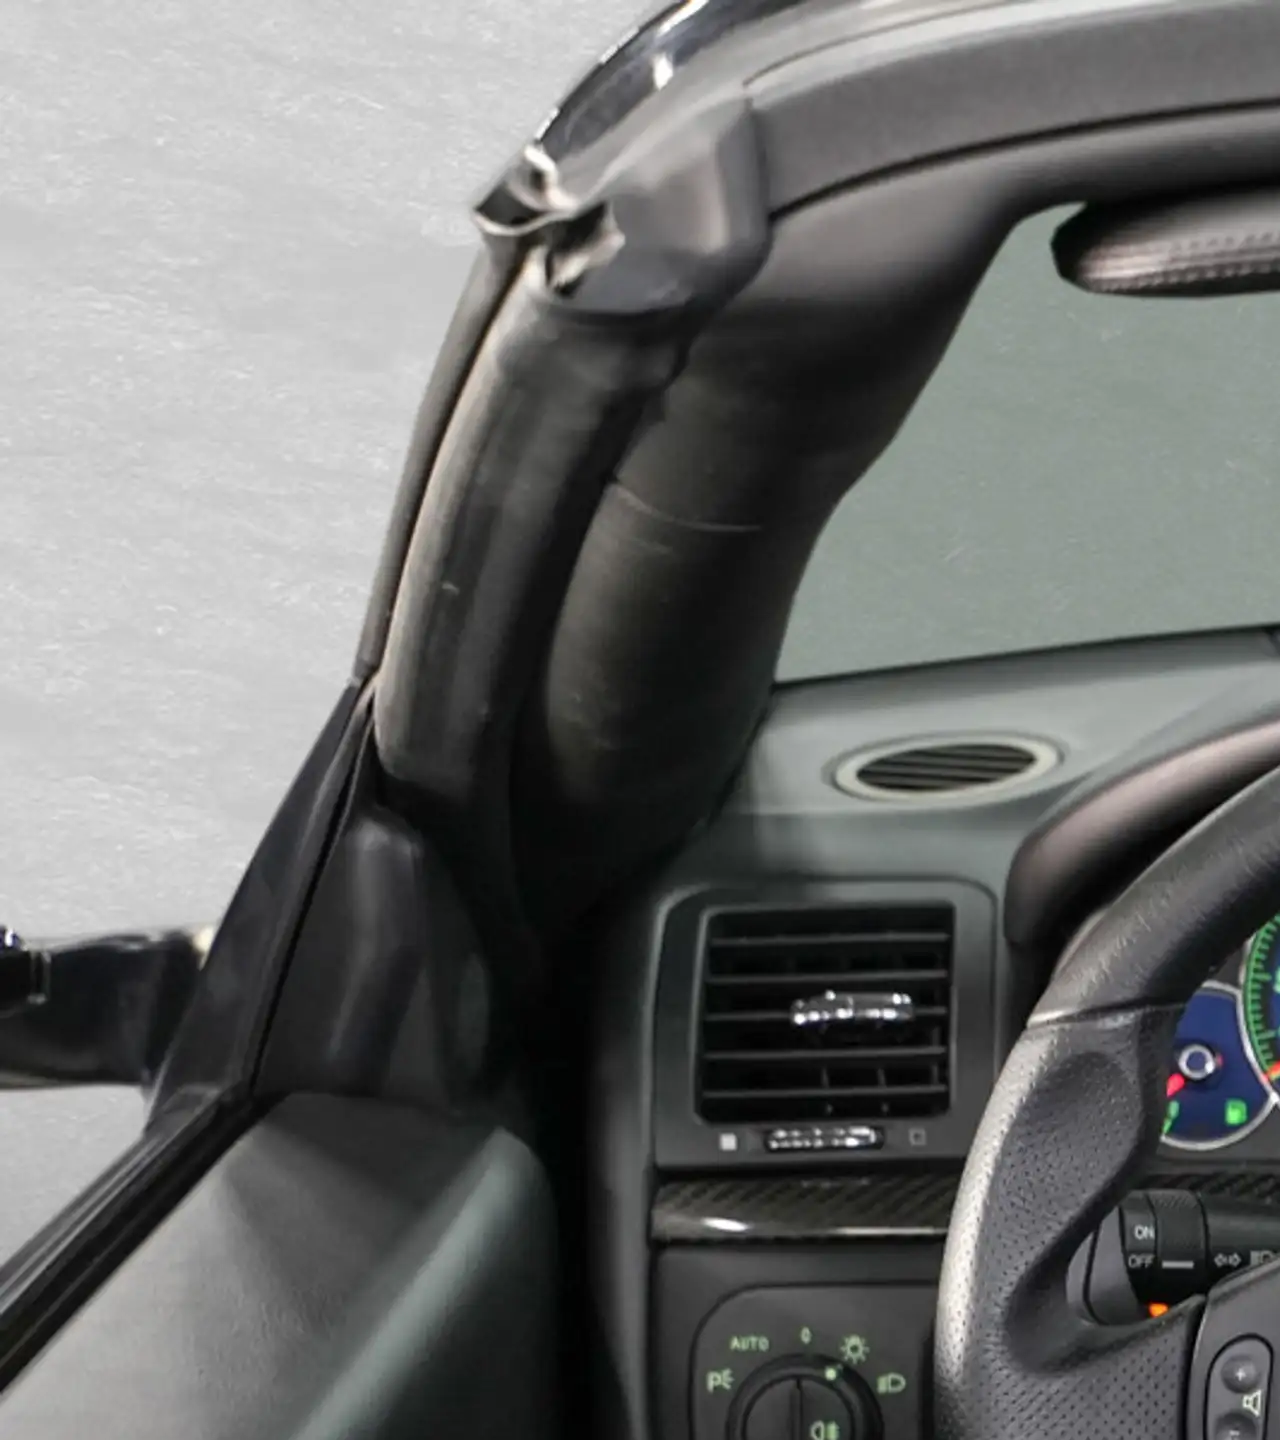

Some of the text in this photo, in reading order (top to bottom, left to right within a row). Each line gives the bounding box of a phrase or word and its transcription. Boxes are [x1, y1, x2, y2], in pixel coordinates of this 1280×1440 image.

[1134, 1224, 1155, 1240] ON
[1128, 1254, 1154, 1268] OFF
[730, 1336, 770, 1351] AUTO
